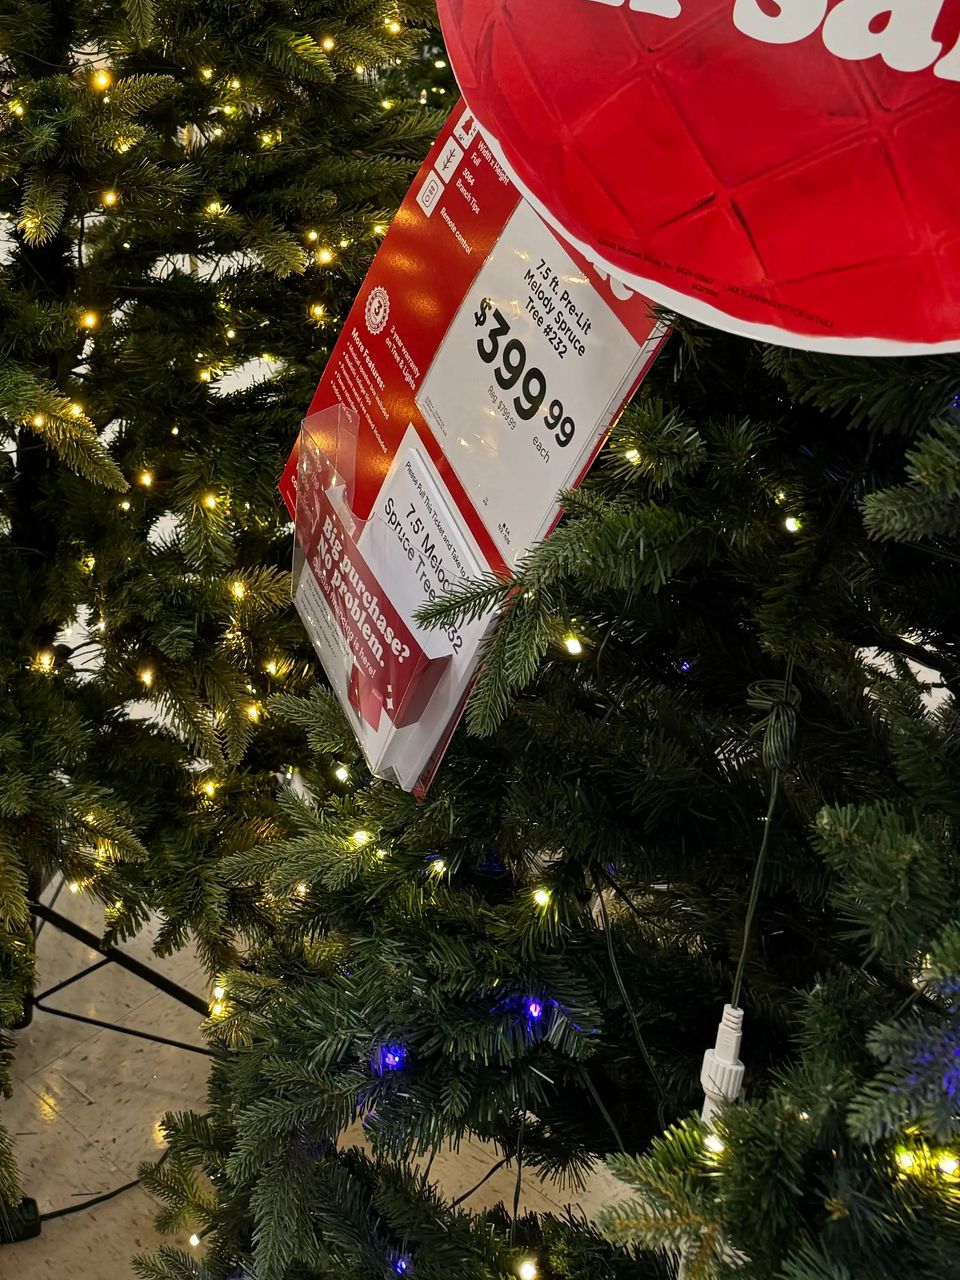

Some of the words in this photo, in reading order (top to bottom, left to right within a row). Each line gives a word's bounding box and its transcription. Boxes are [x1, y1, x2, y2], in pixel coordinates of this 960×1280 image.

[461, 167, 475, 186] 3064
[471, 151, 481, 167] Full
[476, 140, 492, 164] Width
[492, 161, 509, 186] Height
[455, 177, 472, 201] Branch
[469, 196, 480, 215] Tips
[439, 206, 457, 233] Remote
[455, 228, 472, 255] control
[373, 299, 383, 317] 3
[522, 267, 556, 318] Melody
[553, 309, 586, 359] Spruce
[535, 257, 551, 281] 7.5
[548, 274, 562, 296] ft.
[559, 289, 593, 337] Pre-Lit
[523, 295, 545, 328] Tree
[542, 321, 568, 360] #232
[335, 372, 345, 390] Flame
[351, 327, 365, 353] More
[362, 348, 385, 391] Features:
[384, 336, 392, 348] on
[390, 343, 400, 363] Tree
[401, 366, 416, 391] Lights
[392, 331, 403, 349] year
[400, 344, 420, 379] warranty
[340, 363, 353, 388] Premium
[351, 385, 361, 403] metal
[366, 412, 375, 430] stand
[373, 426, 388, 454] included
[375, 394, 389, 419] included
[487, 384, 499, 404] Reg.
[496, 398, 517, 431] $799.99
[531, 433, 551, 464] each
[404, 459, 418, 486] Please
[416, 481, 426, 500] Pull
[423, 495, 433, 514] This
[430, 509, 445, 538] Ticket
[442, 532, 453, 552] and
[450, 546, 462, 570] Take
[459, 565, 466, 578] to
[382, 496, 417, 561] Spruce
[412, 554, 438, 604] Tree
[315, 534, 333, 570] No
[328, 567, 389, 668] problem.
[320, 515, 344, 560] Big
[337, 552, 411, 666] purchase?
[328, 590, 355, 642] financing
[357, 649, 376, 680] here!
